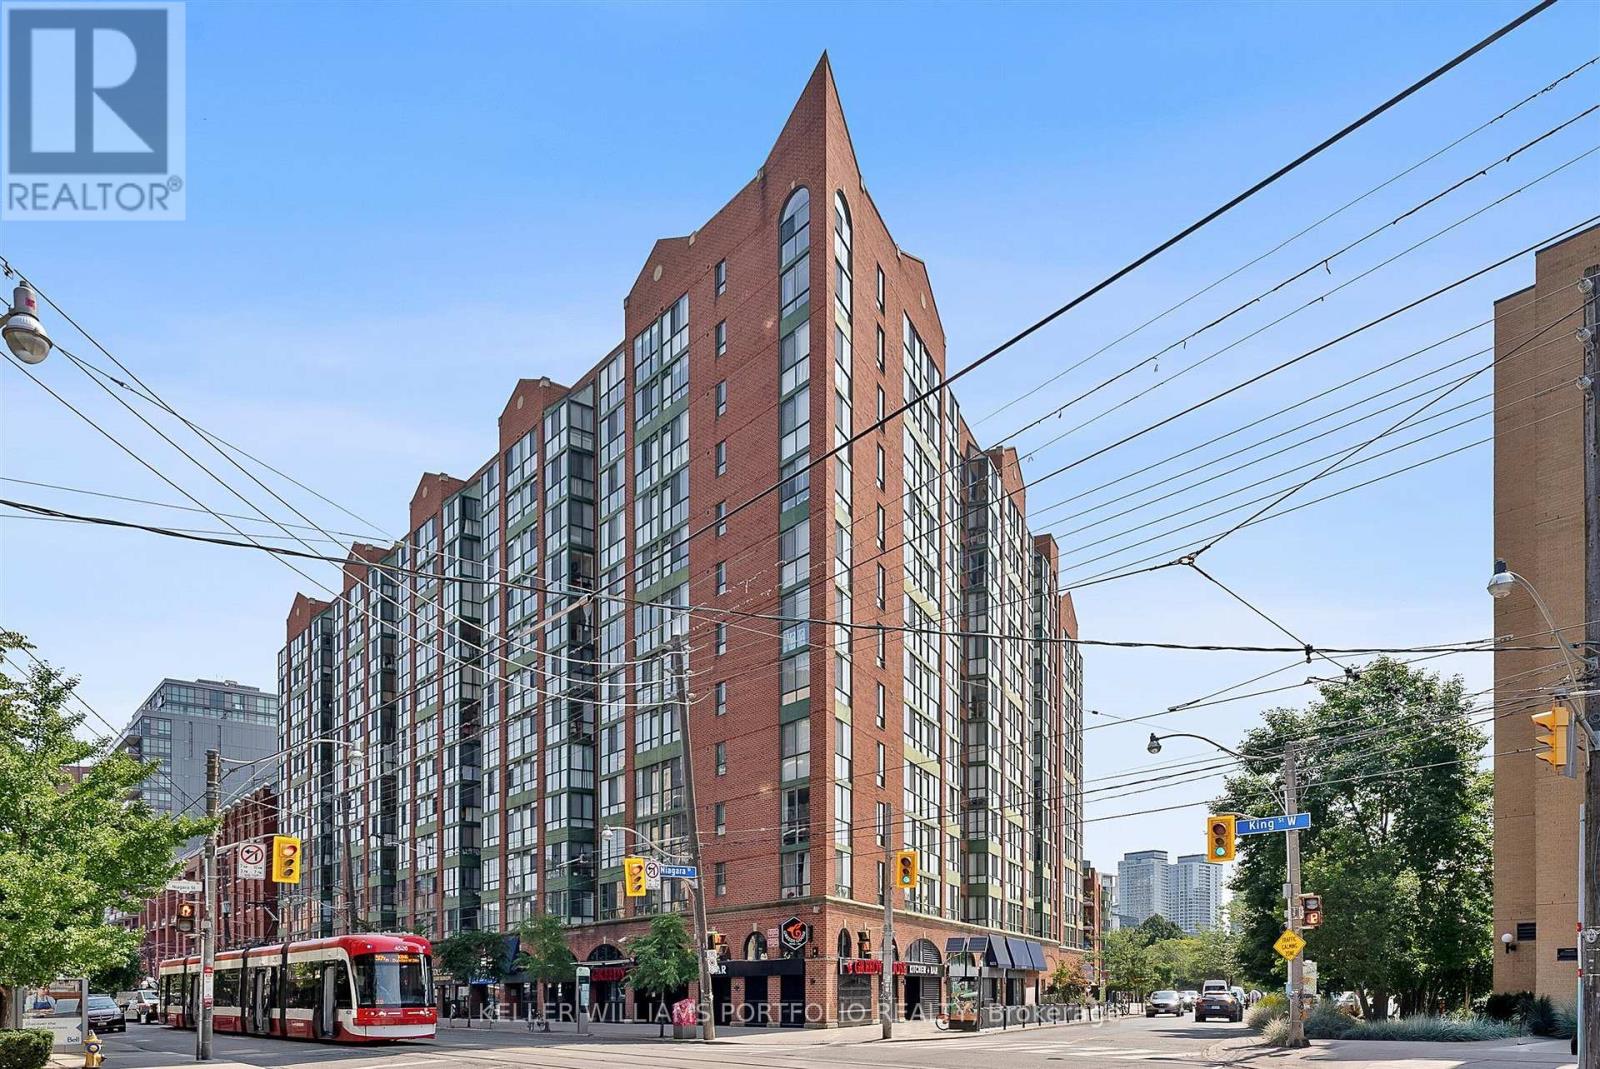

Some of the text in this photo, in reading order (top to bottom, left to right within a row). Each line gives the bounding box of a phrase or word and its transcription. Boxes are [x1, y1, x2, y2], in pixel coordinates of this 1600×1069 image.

[1249, 820, 1275, 831] King
[1287, 816, 1297, 826] W
[660, 867, 686, 876] Niagara
